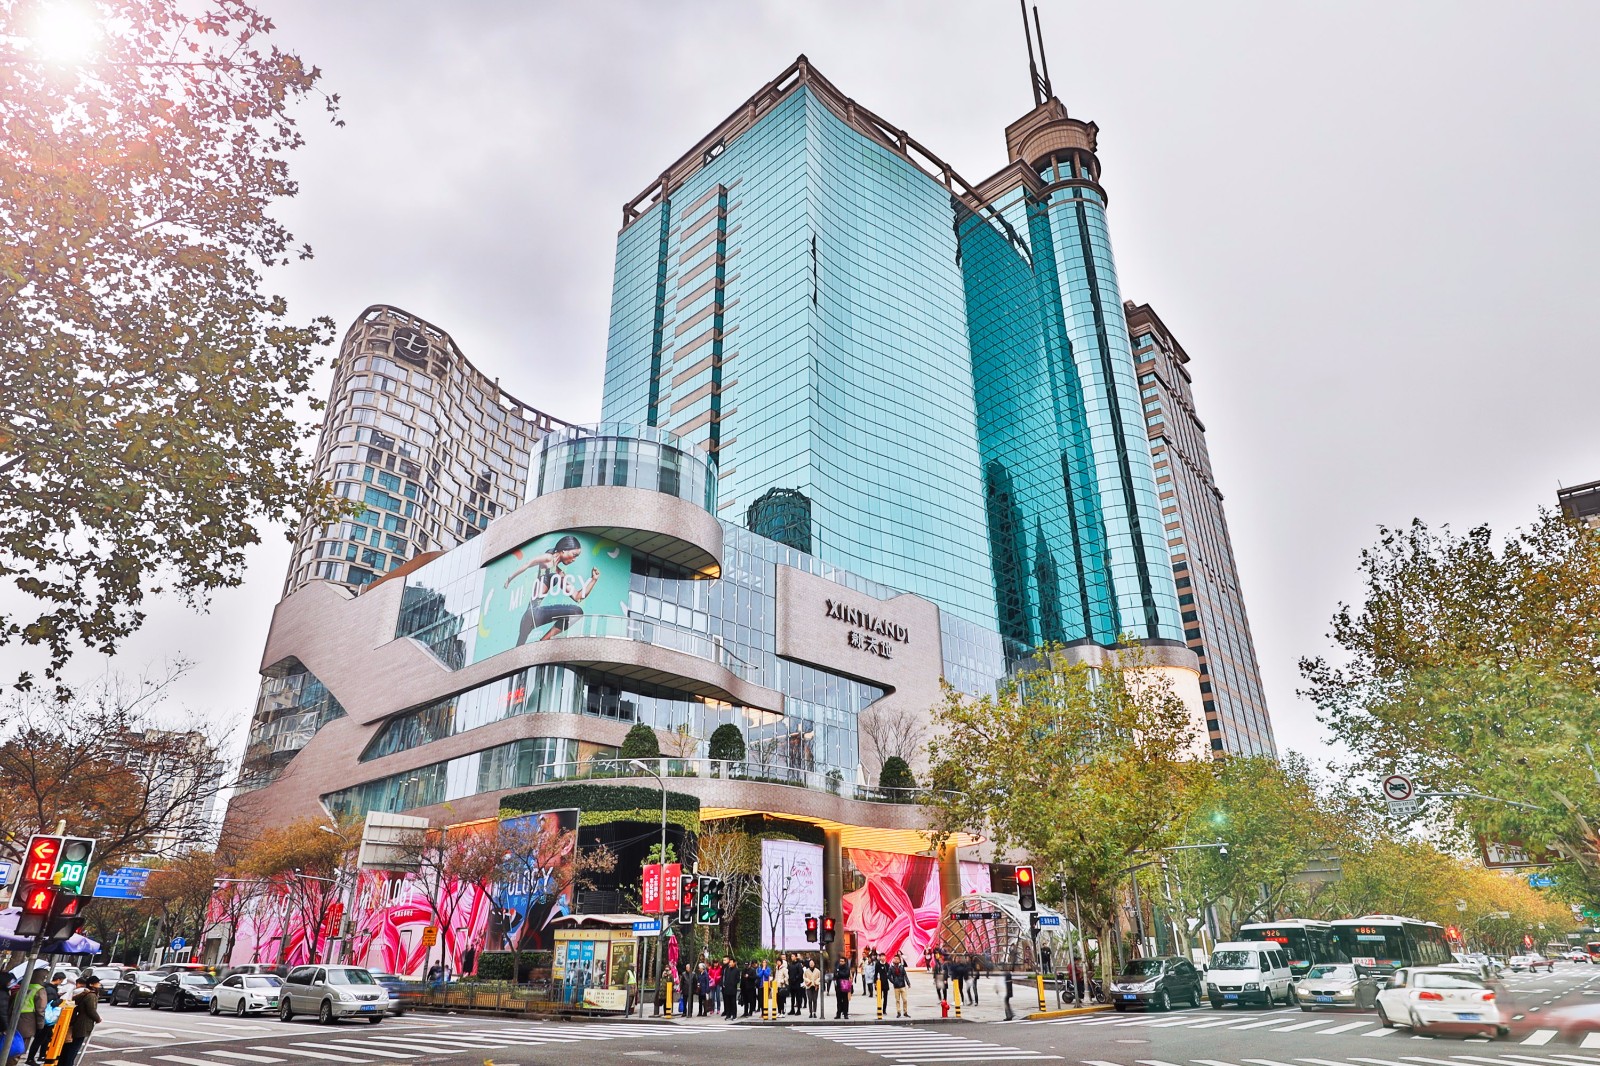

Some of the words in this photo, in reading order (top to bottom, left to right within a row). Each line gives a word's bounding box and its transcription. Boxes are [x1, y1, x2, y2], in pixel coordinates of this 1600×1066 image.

[826, 598, 910, 644] XINTIANDI
[848, 630, 893, 660] 新天地
[32, 863, 51, 880] 12
[61, 864, 83, 882] 08
